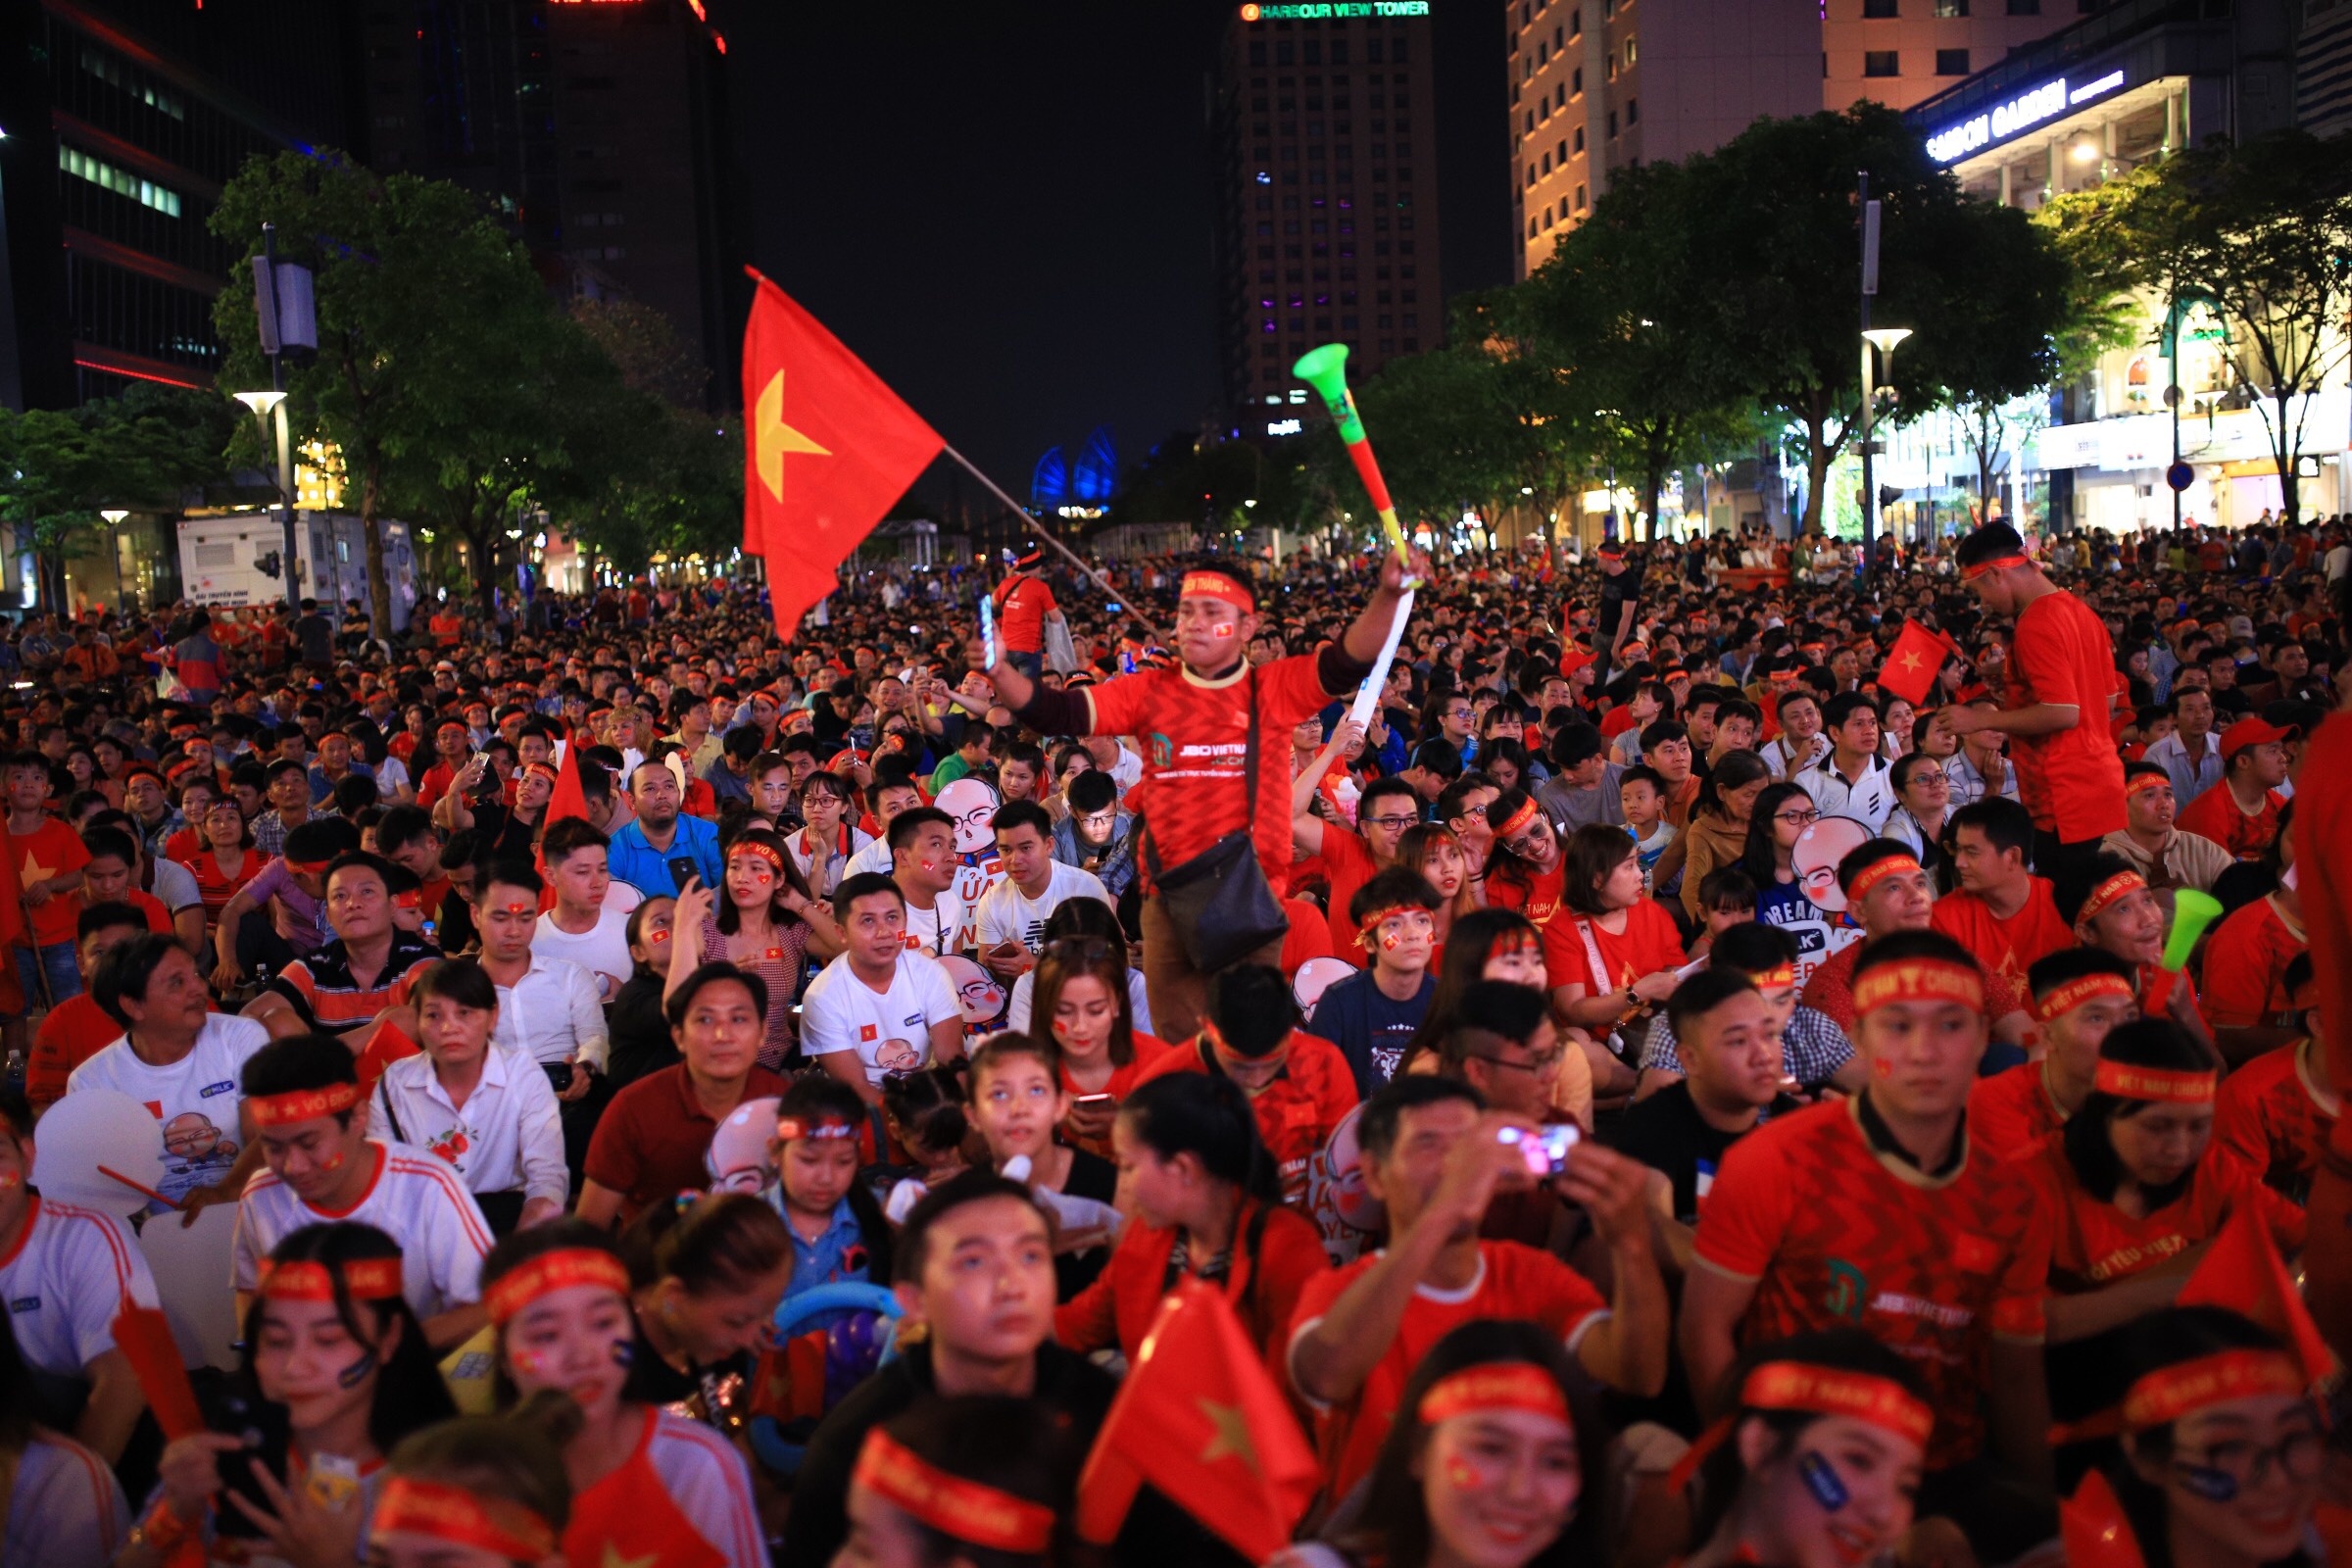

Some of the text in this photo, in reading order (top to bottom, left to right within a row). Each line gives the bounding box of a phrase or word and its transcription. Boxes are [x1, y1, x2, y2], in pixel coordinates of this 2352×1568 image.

[1260, 1, 1429, 18] HARBOUR VIEW TOWER
[1991, 77, 2066, 138] GARDEN
[1212, 744, 1247, 756] VIETNA
[2101, 881, 2122, 899] NAM
[1533, 903, 1550, 915] NAM
[2074, 980, 2101, 996] NAM
[304, 1097, 327, 1112] VÔ
